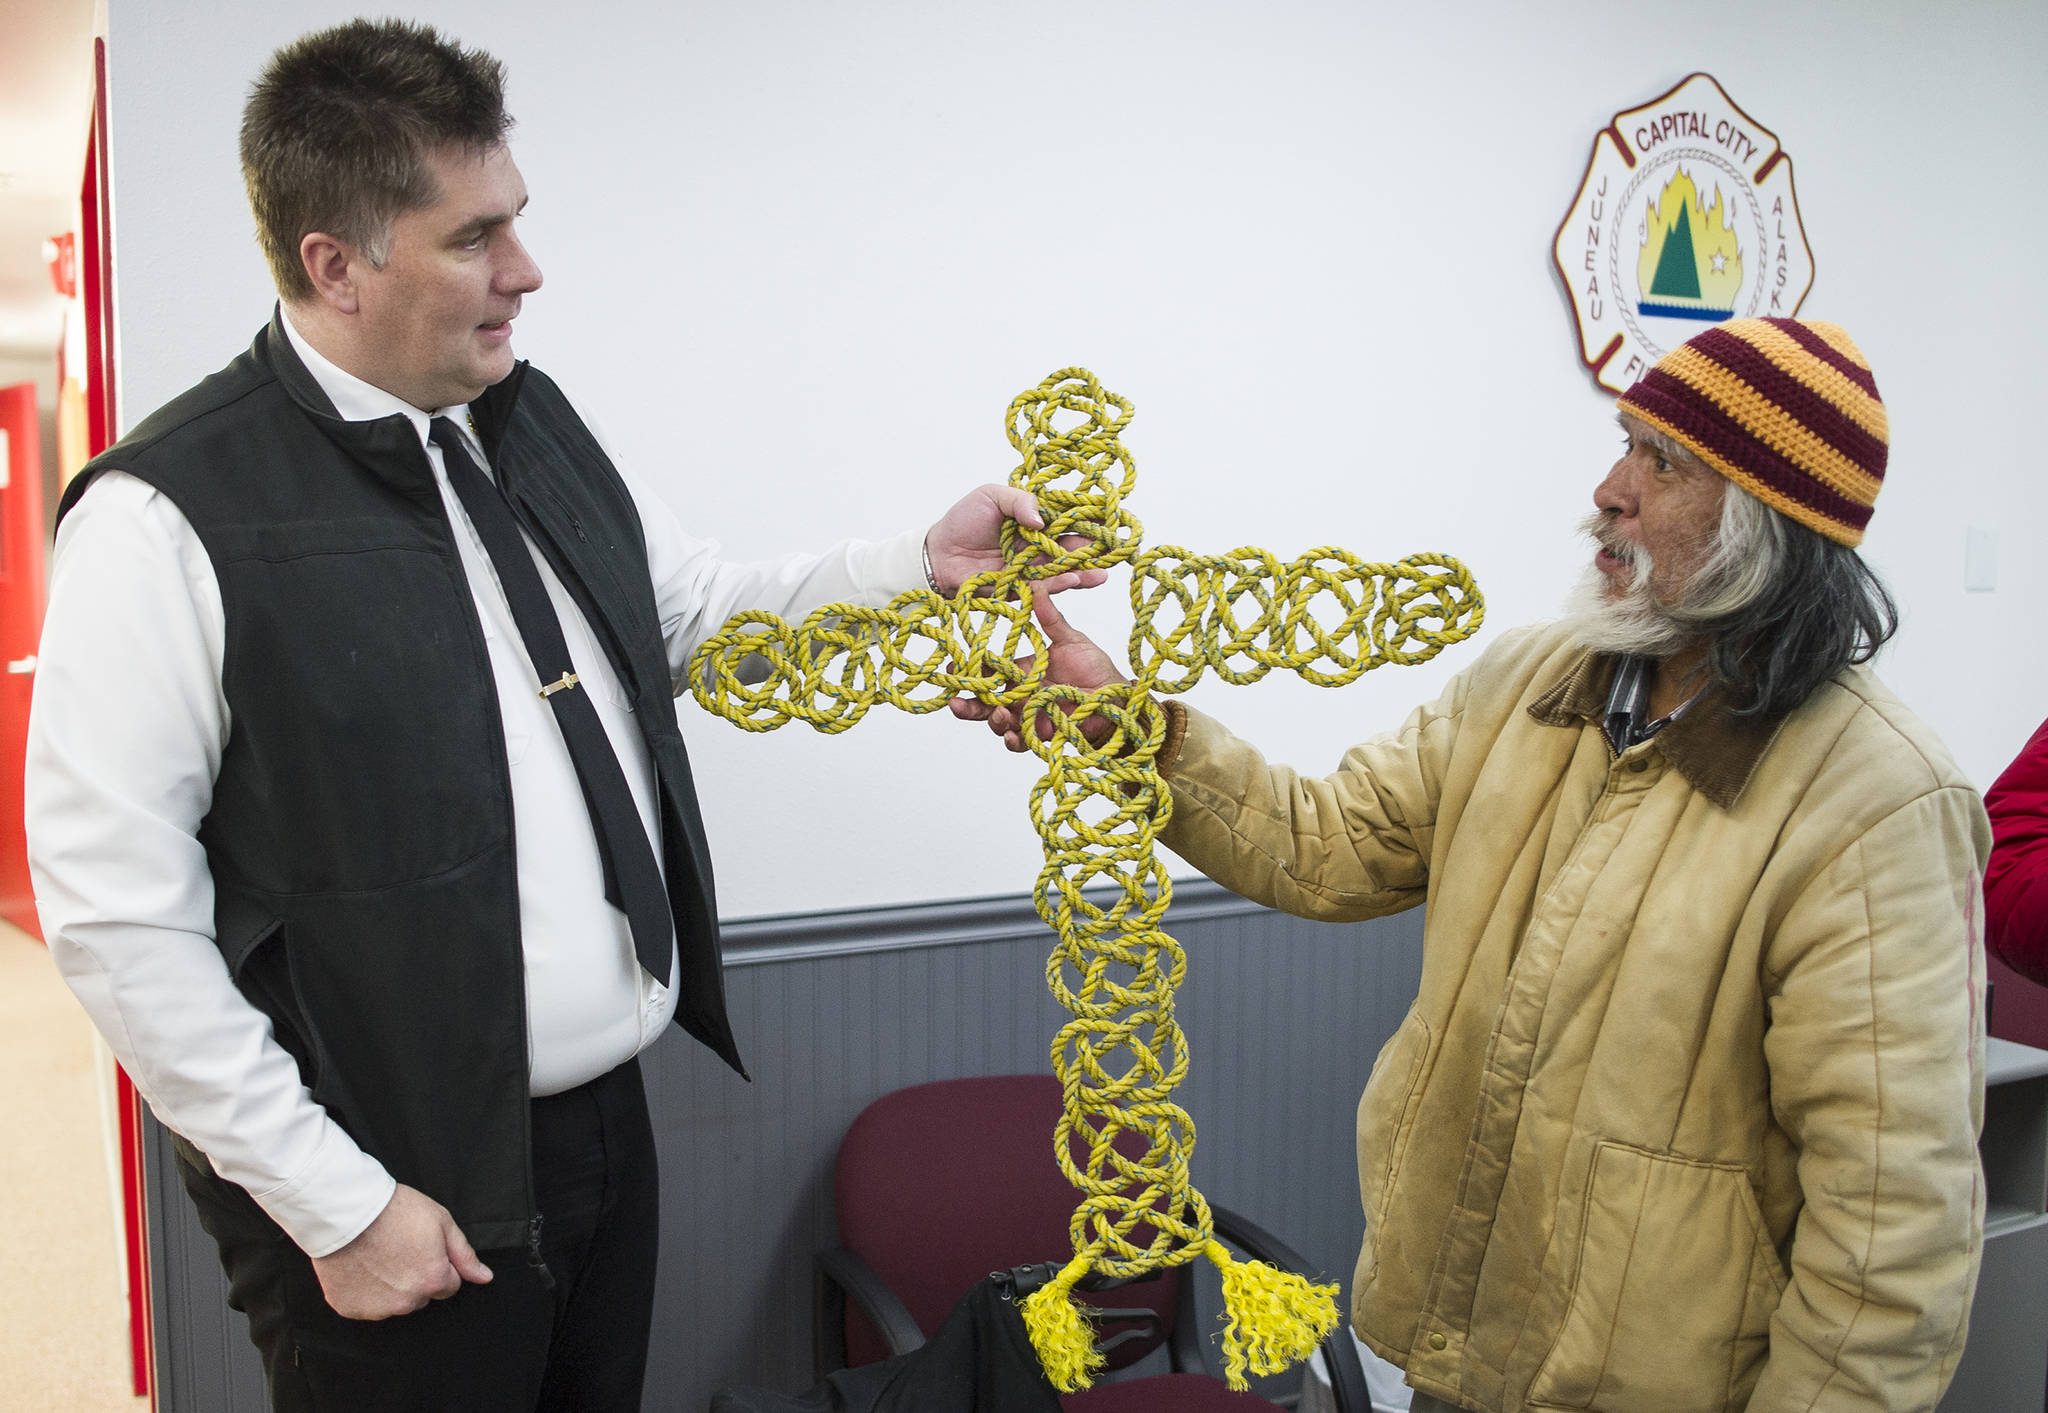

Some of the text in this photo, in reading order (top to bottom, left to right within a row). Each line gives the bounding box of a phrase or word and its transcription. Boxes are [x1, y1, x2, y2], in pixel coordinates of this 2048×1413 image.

[1636, 111, 1758, 164] CAPITAL CITY
[1584, 175, 1608, 321] JUNEAU
[1767, 195, 1788, 318] ALASK
[1624, 354, 1651, 382] FI
